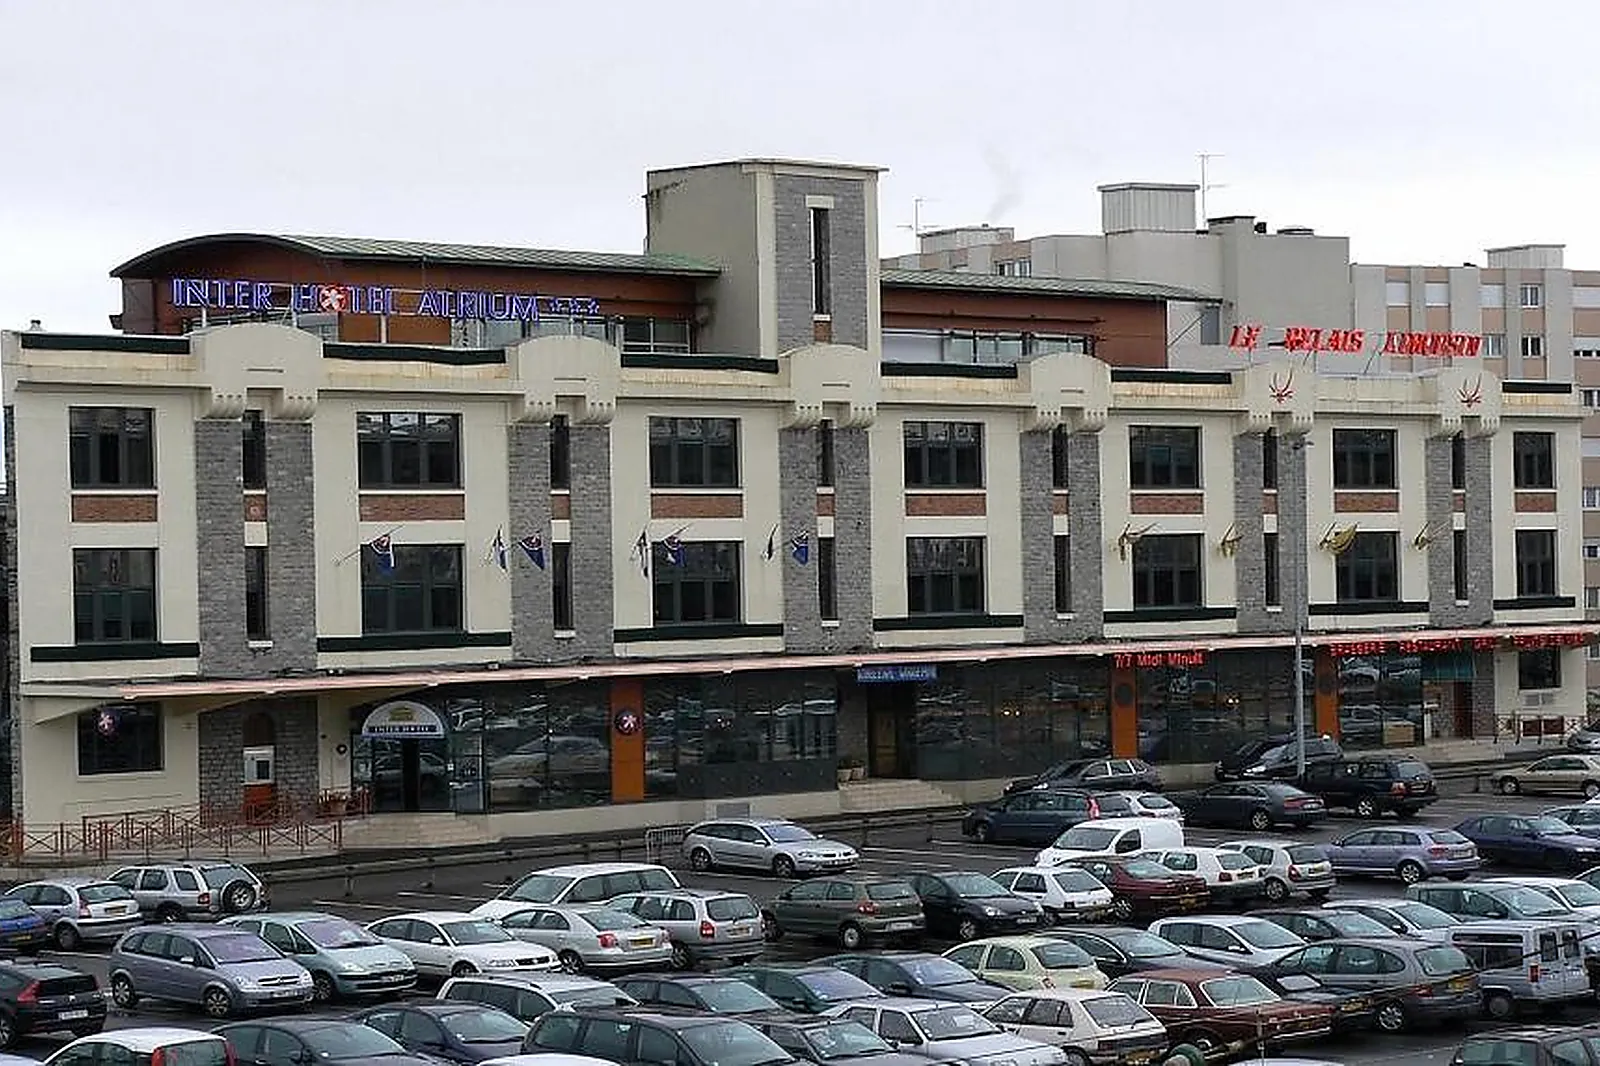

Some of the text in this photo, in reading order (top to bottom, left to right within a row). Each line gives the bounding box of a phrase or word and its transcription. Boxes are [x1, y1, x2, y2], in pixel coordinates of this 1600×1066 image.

[173, 278, 273, 310] INTER
[417, 290, 540, 322] ATRIUM
[1113, 652, 1133, 668] 7/7
